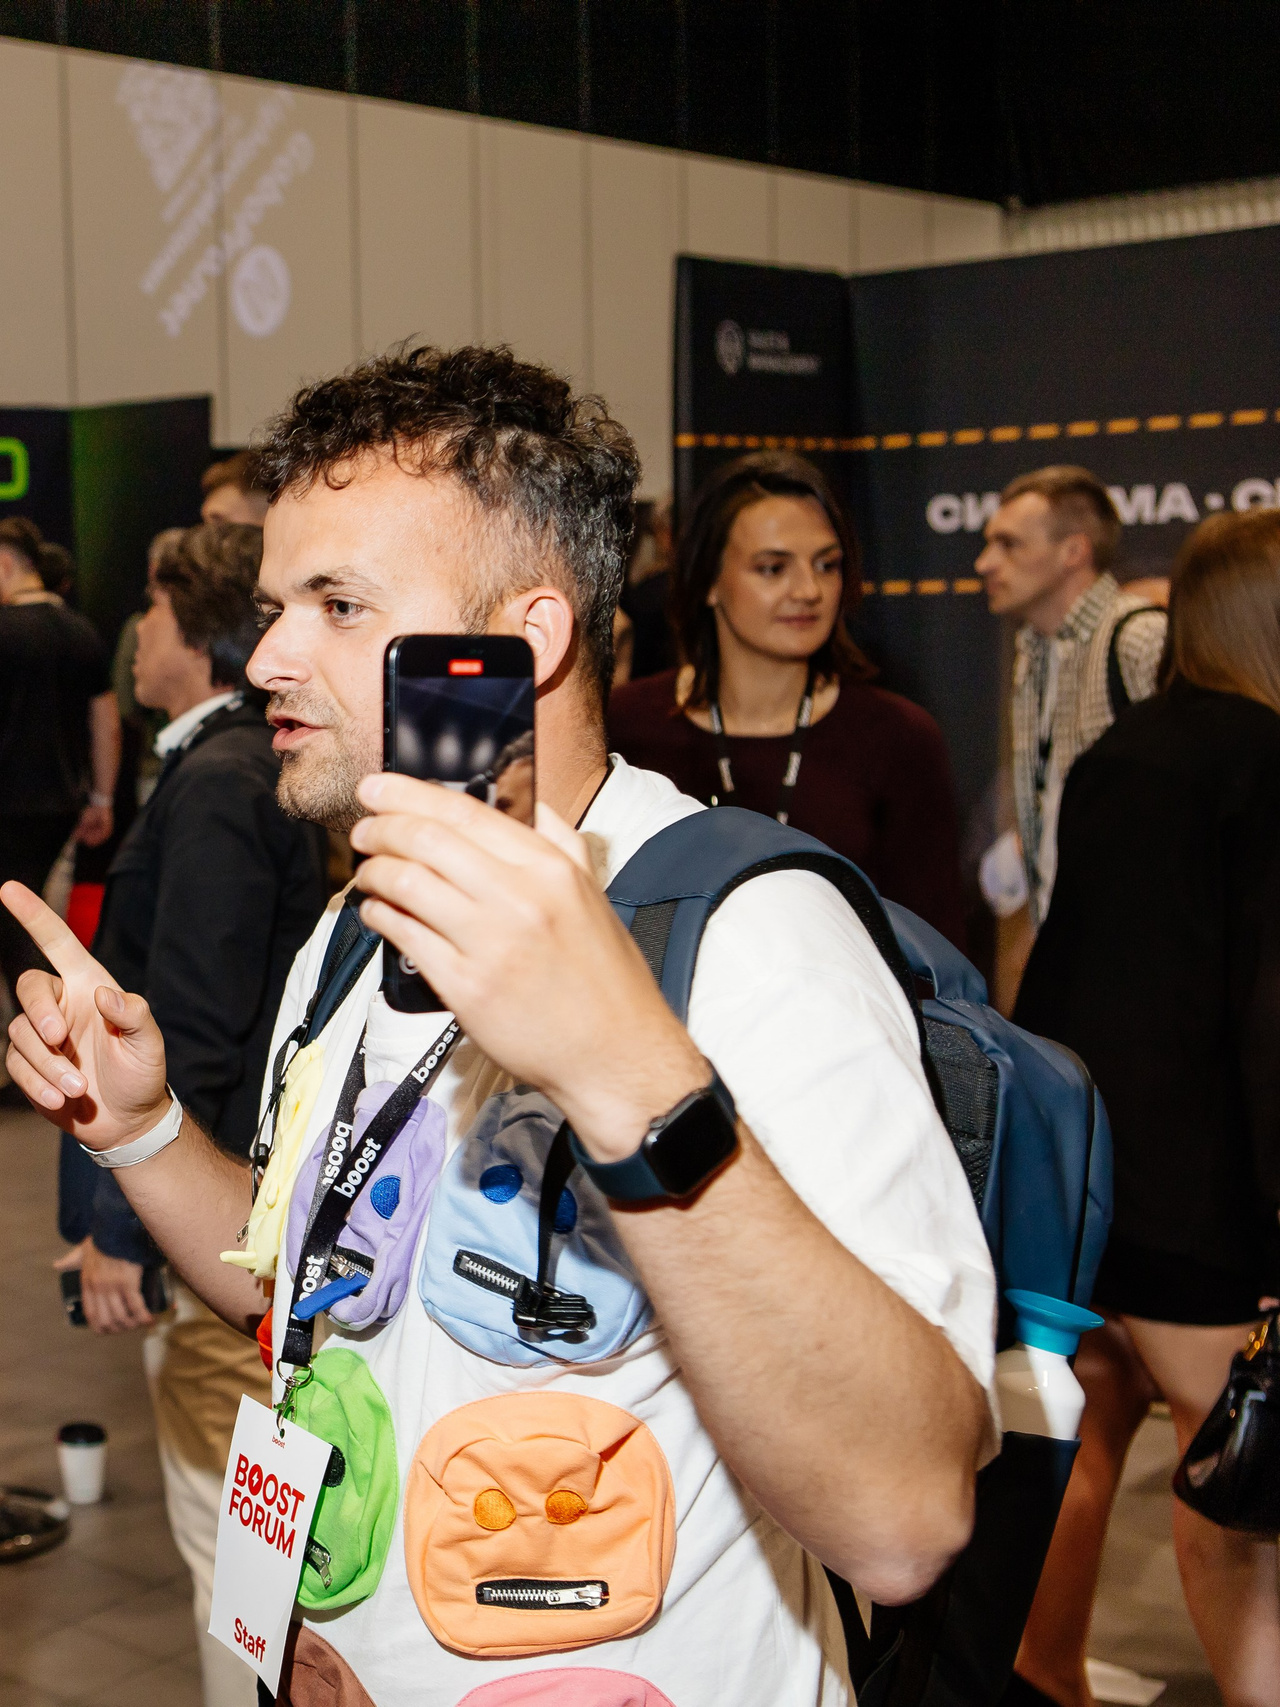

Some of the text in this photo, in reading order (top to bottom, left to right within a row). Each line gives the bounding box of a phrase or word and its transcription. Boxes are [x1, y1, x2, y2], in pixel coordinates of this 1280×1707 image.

[411, 1022, 460, 1084] boost
[333, 1137, 382, 1199] boost
[233, 1453, 306, 1523] BOOST
[228, 1487, 297, 1560] FORUM
[233, 1617, 267, 1664] Staff
